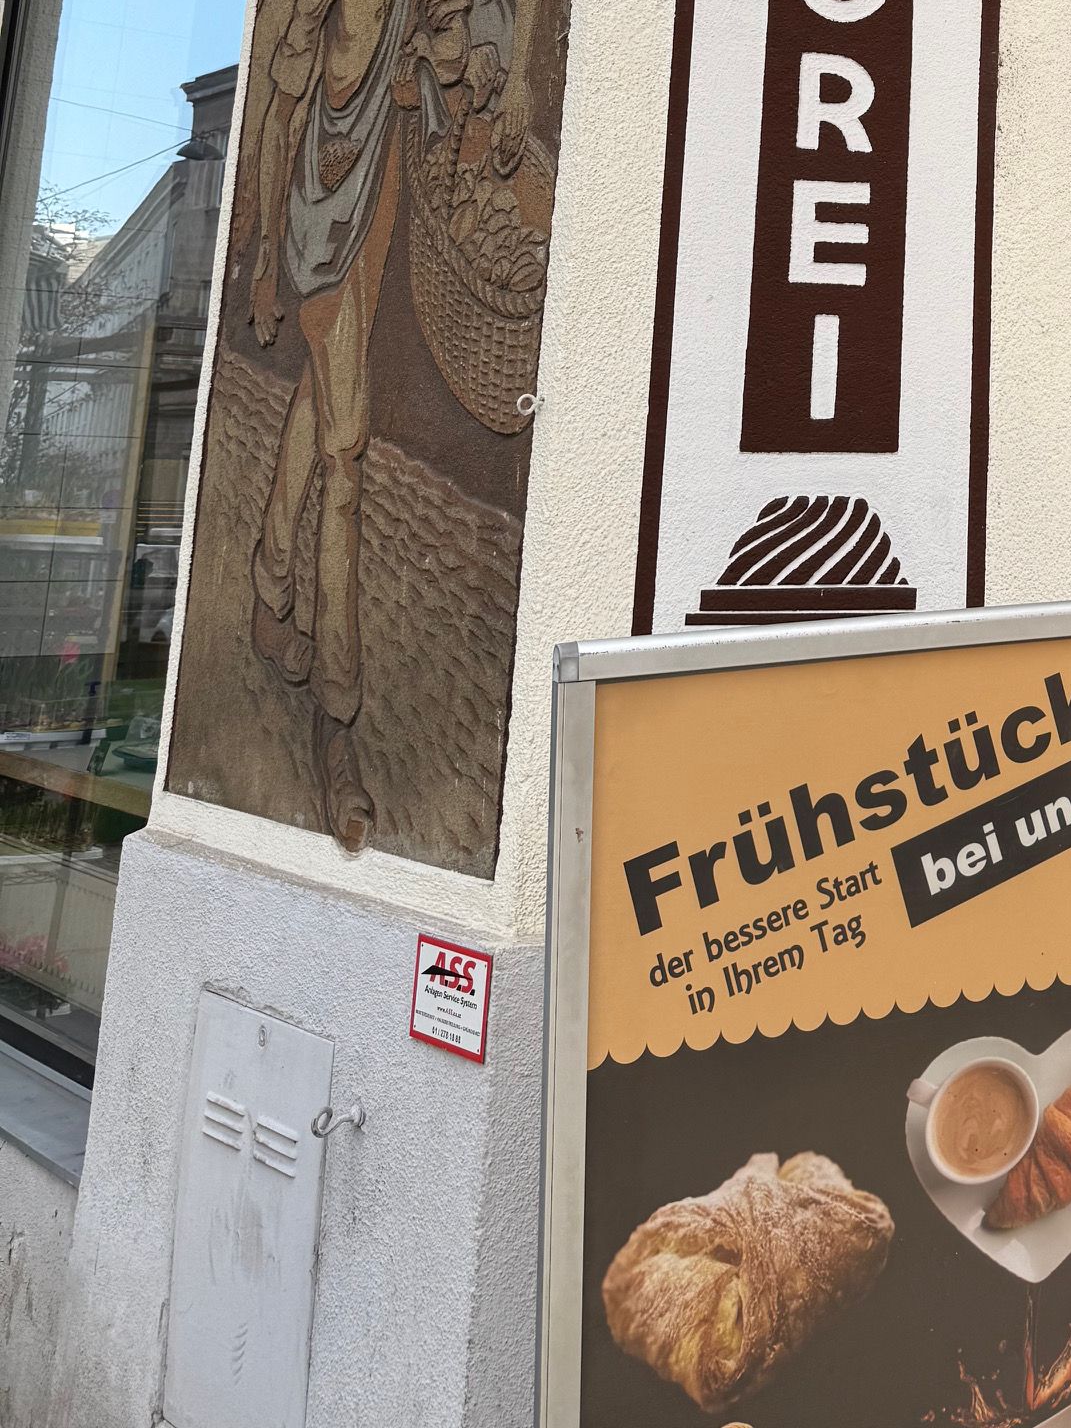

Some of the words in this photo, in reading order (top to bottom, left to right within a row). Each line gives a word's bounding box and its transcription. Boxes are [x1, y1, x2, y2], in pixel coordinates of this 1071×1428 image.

[920, 823, 1003, 895] bei
[650, 949, 693, 988] der
[702, 897, 809, 962] bessere
[817, 861, 882, 910] Start
[685, 984, 715, 1015] in
[723, 942, 804, 998] Ihrem
[810, 915, 866, 955] Tag
[425, 985, 443, 998] Anlagen
[443, 991, 460, 1004] Service
[460, 997, 477, 1010] System
